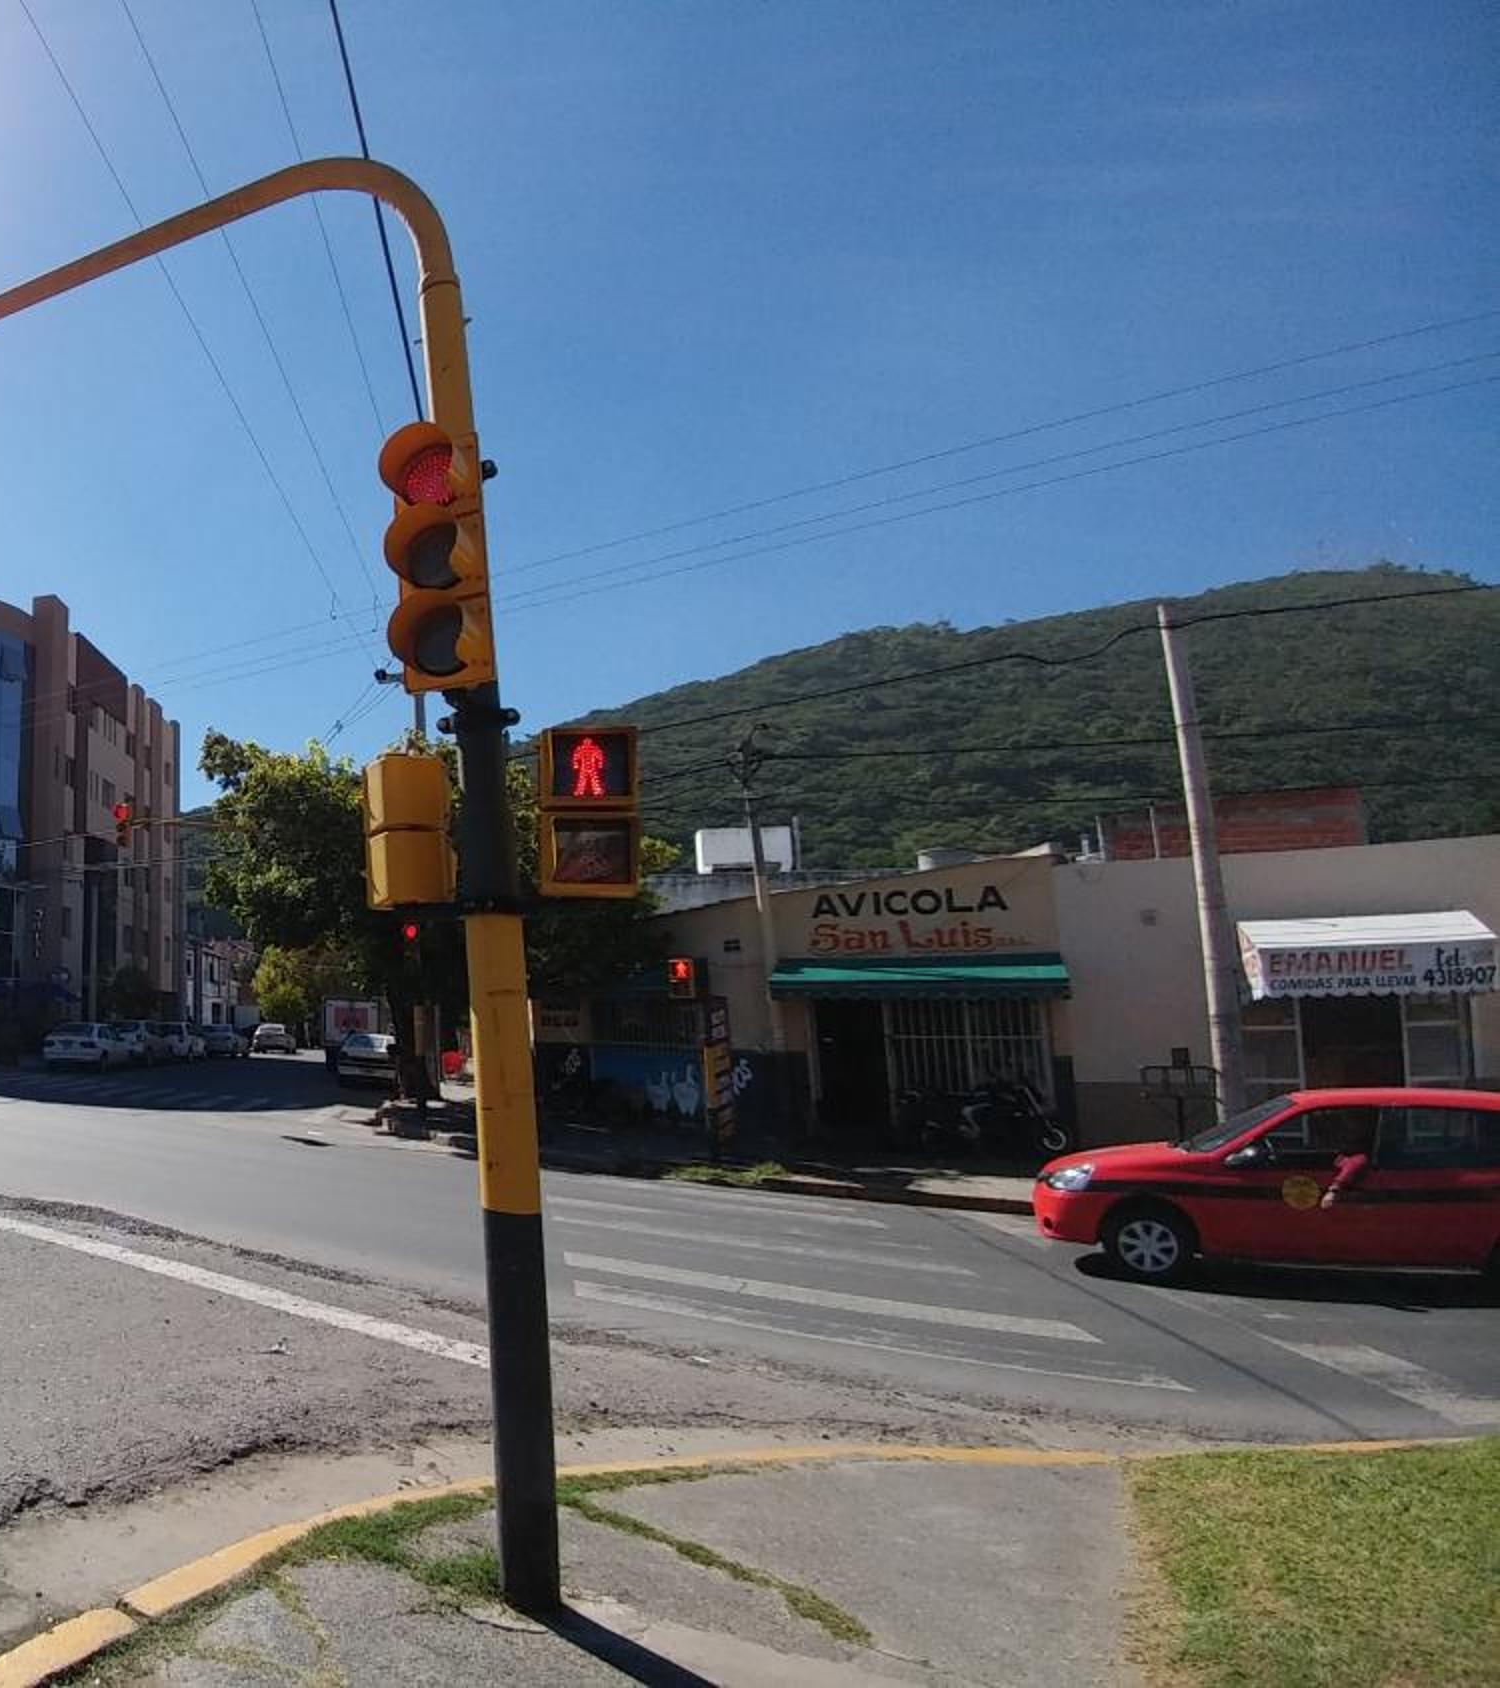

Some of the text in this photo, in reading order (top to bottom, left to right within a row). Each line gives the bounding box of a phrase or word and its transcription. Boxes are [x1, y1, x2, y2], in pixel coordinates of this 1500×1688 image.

[811, 885, 1010, 918] AVICOLA
[810, 919, 994, 950] San Luis
[1269, 949, 1413, 975] EMANUEL
[1269, 976, 1333, 991] COMIDAS
[1338, 976, 1372, 989] PARA
[1423, 965, 1497, 987] 4318907
